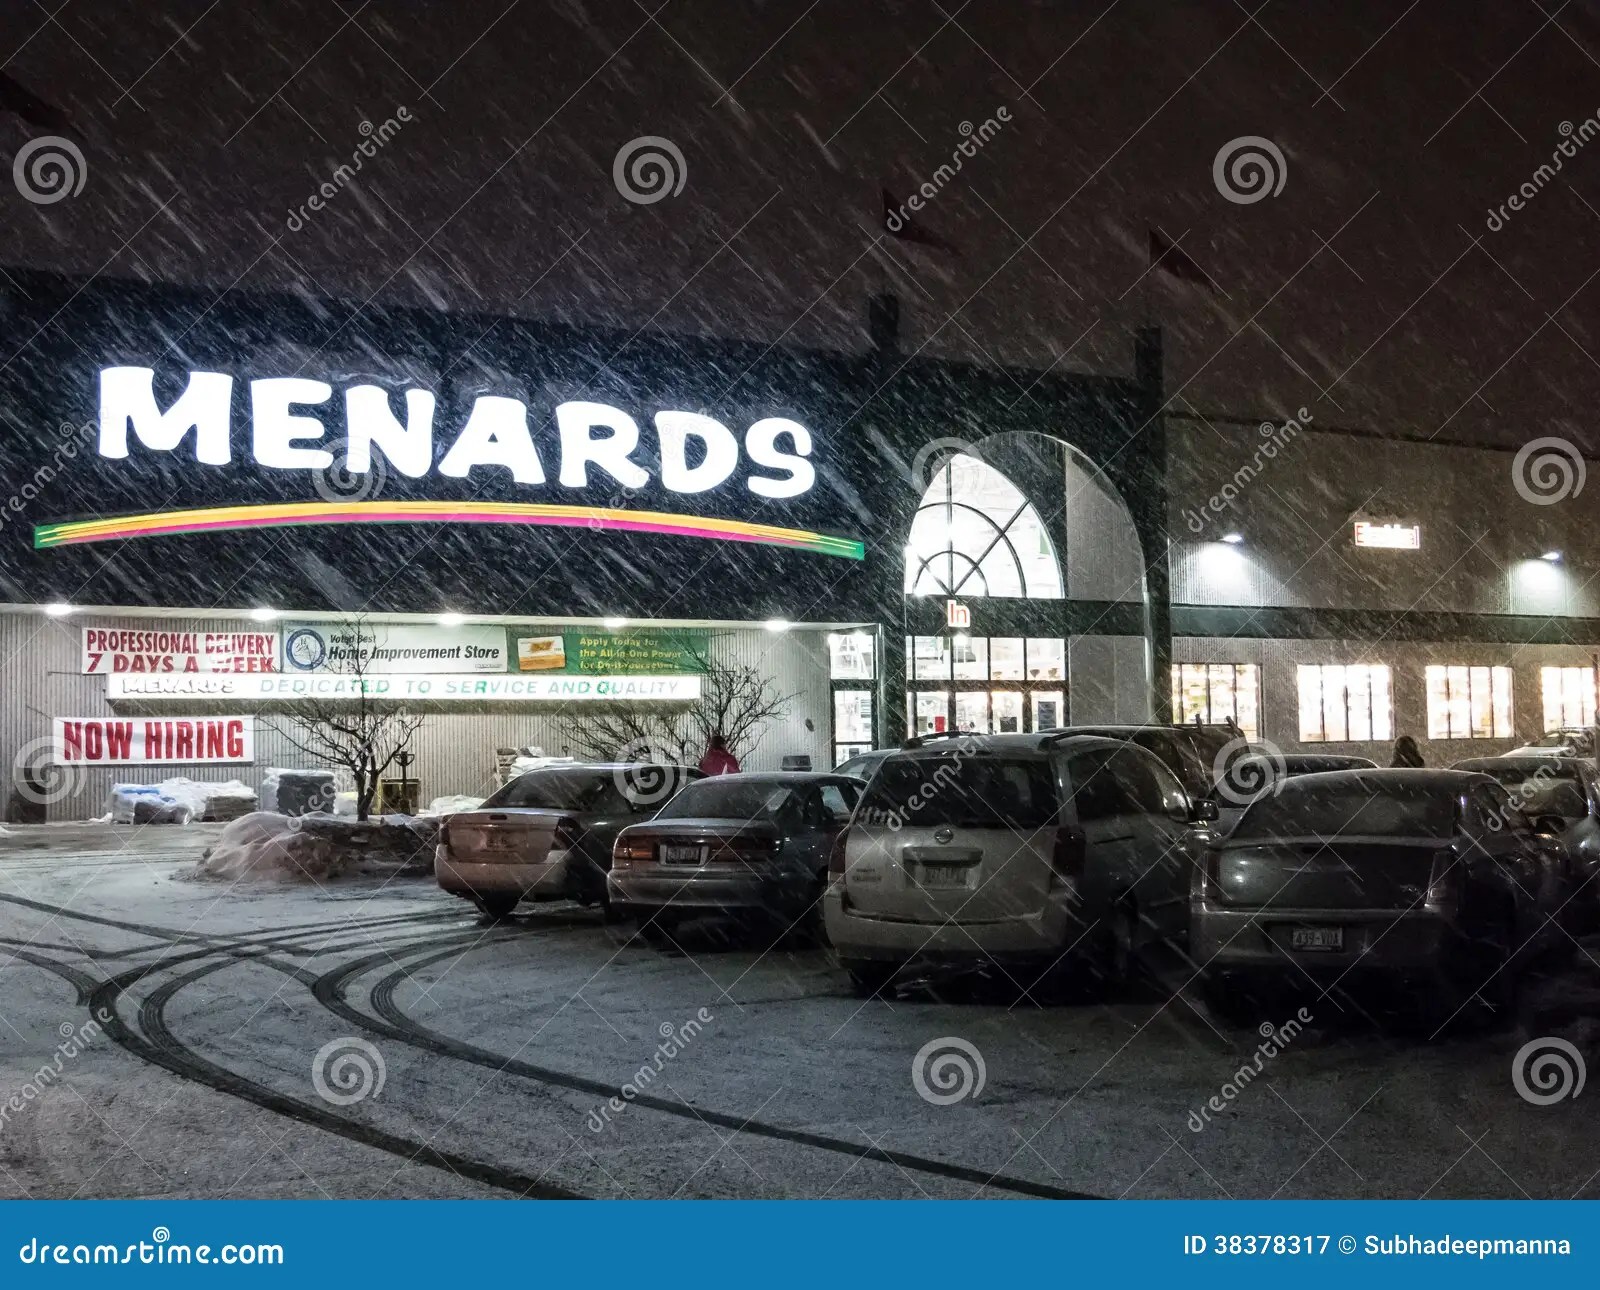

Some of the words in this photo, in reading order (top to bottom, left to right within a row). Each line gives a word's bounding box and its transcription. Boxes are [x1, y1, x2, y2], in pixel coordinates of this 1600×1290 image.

[100, 366, 815, 499] MENARDS
[948, 600, 970, 627] In
[87, 630, 199, 654] PROFESSIONAL
[206, 634, 274, 655] DELIVERY
[358, 634, 376, 643] Best
[580, 637, 608, 646] Apply
[612, 637, 640, 646] Today
[328, 646, 368, 660] Home
[371, 645, 460, 661] Improvement
[464, 645, 499, 658] Store
[580, 649, 596, 658] the
[88, 653, 103, 672] 7
[113, 654, 174, 672] DAYS
[184, 656, 199, 673] A
[580, 661, 594, 669] for
[260, 679, 390, 693] DEDICATED
[406, 680, 431, 693] TO
[446, 680, 537, 694] SERVICE
[548, 681, 591, 694] AND
[597, 681, 679, 695] QUALITY
[64, 722, 133, 760] NOW
[145, 720, 244, 759] HIRING
